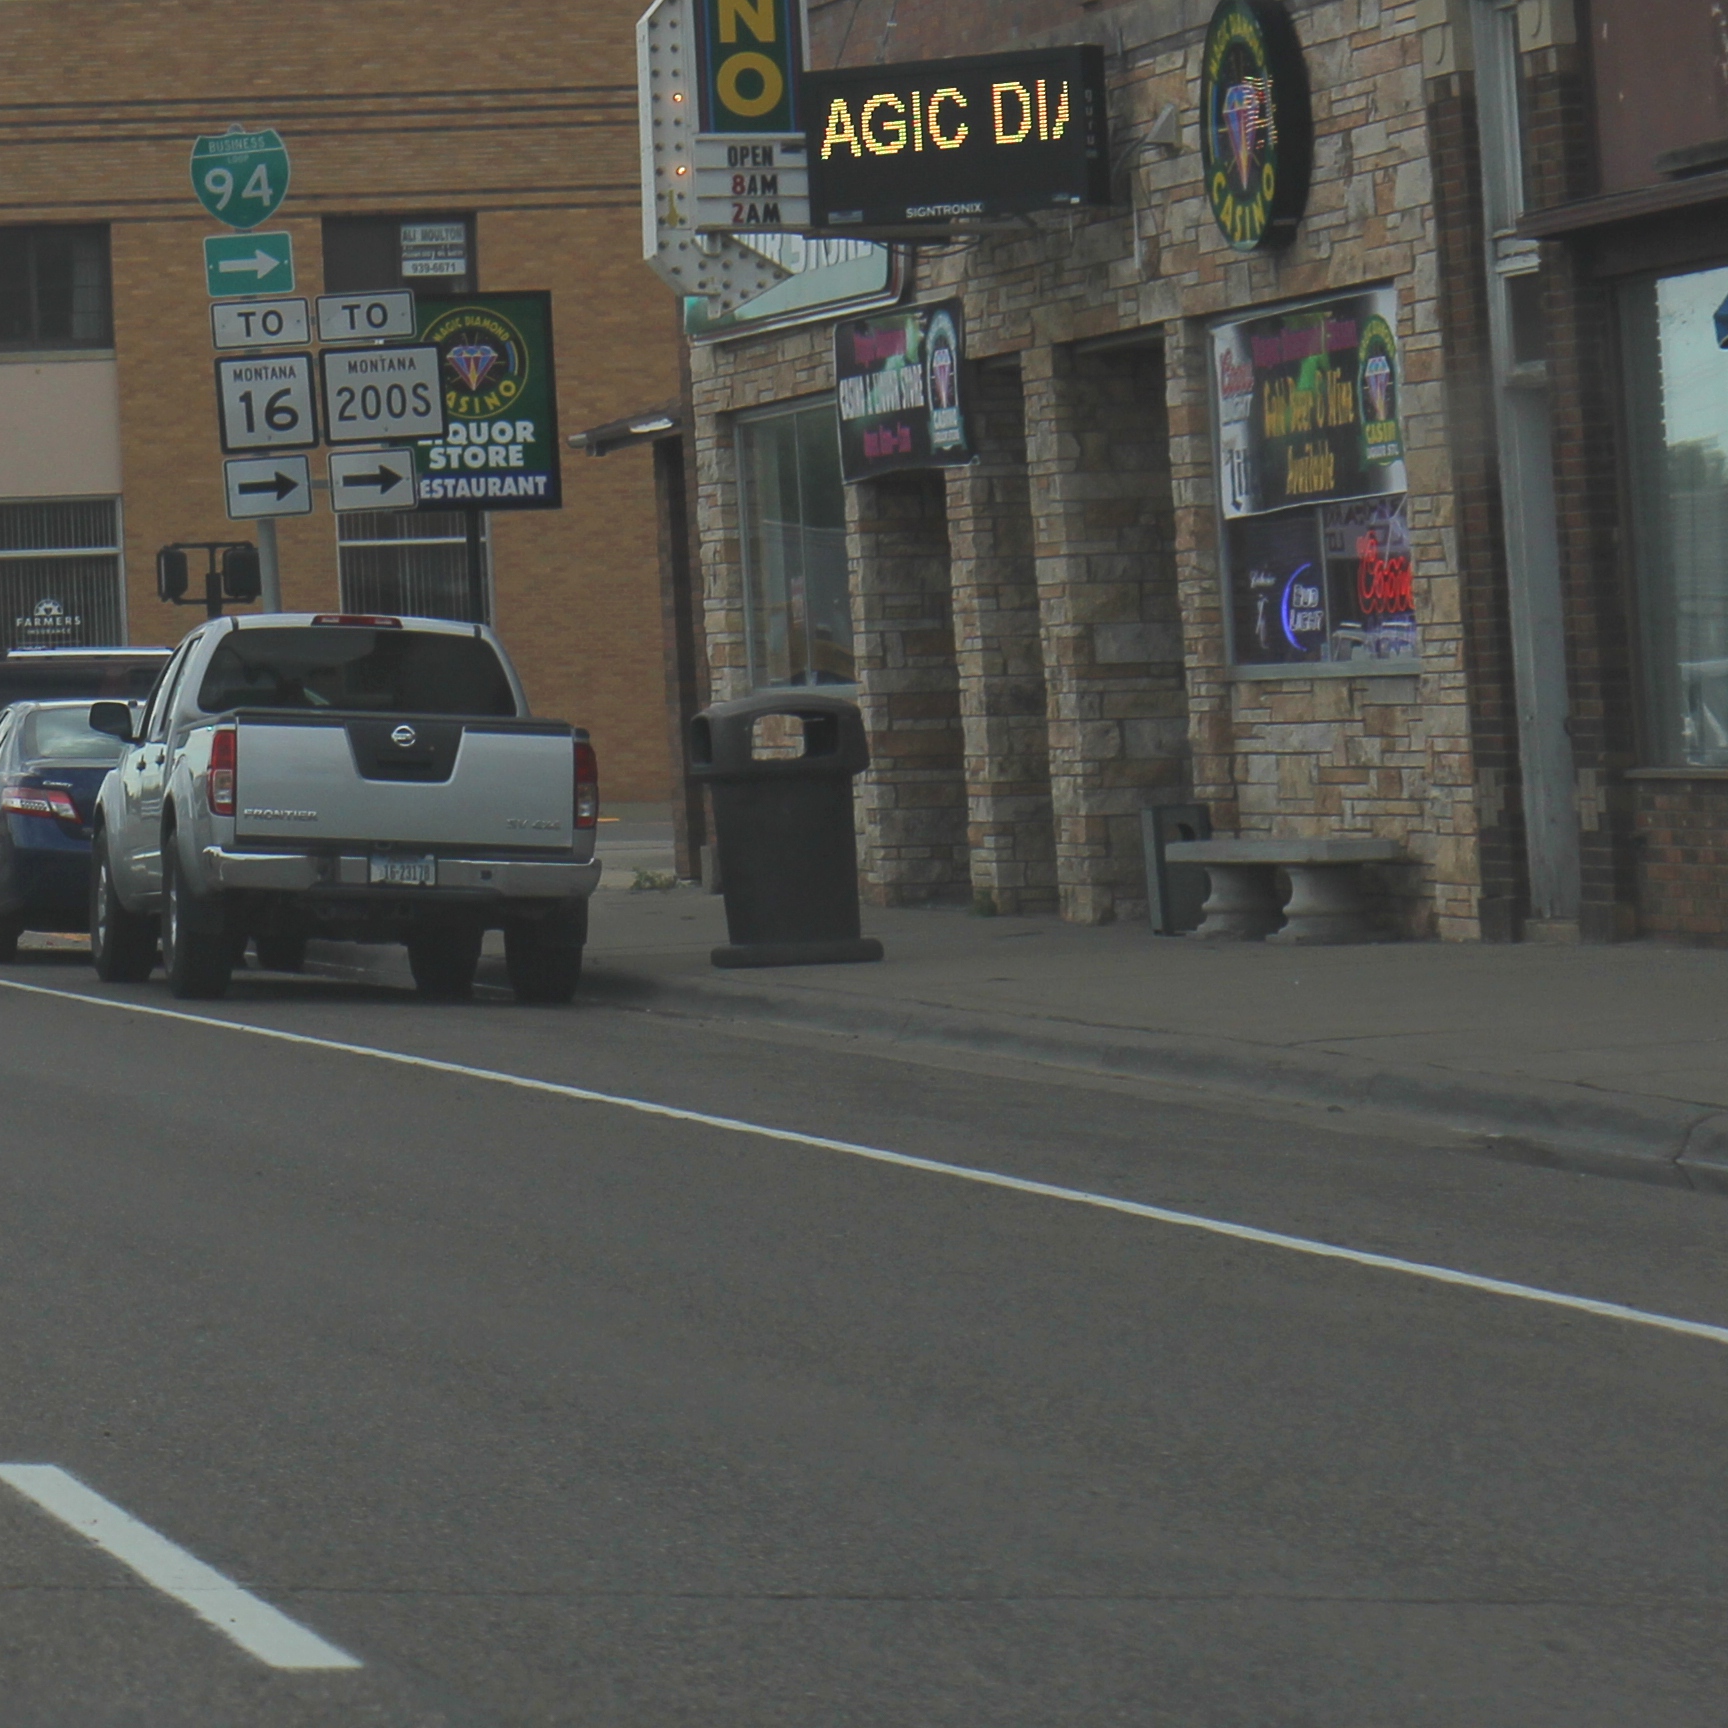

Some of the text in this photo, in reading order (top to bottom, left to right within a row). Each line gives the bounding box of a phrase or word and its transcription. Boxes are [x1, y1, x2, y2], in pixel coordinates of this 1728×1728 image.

[821, 87, 969, 160] AGIC
[208, 136, 265, 153] BUSINESS
[727, 145, 774, 166] OPEN
[205, 163, 273, 211] 94
[732, 174, 778, 195] 8AM
[732, 203, 781, 223] 2AM
[906, 202, 983, 218] SIGNTRONIX
[1213, 162, 1276, 242] CASINO
[411, 261, 457, 274] 939-6671
[237, 310, 284, 338] TO
[341, 302, 388, 330] TO
[433, 315, 510, 343] MAGIC DIAMOND
[233, 364, 296, 383] MONTANA
[348, 357, 416, 374] MONTANA
[336, 382, 432, 422] 200S
[446, 380, 516, 414] ASINO
[239, 387, 299, 433] 16
[417, 421, 536, 446] QUOR
[429, 444, 524, 469] STORE
[420, 475, 548, 500] ESTAURANT
[16, 615, 82, 627] FARMERS
[243, 808, 319, 822] FRONTIER
